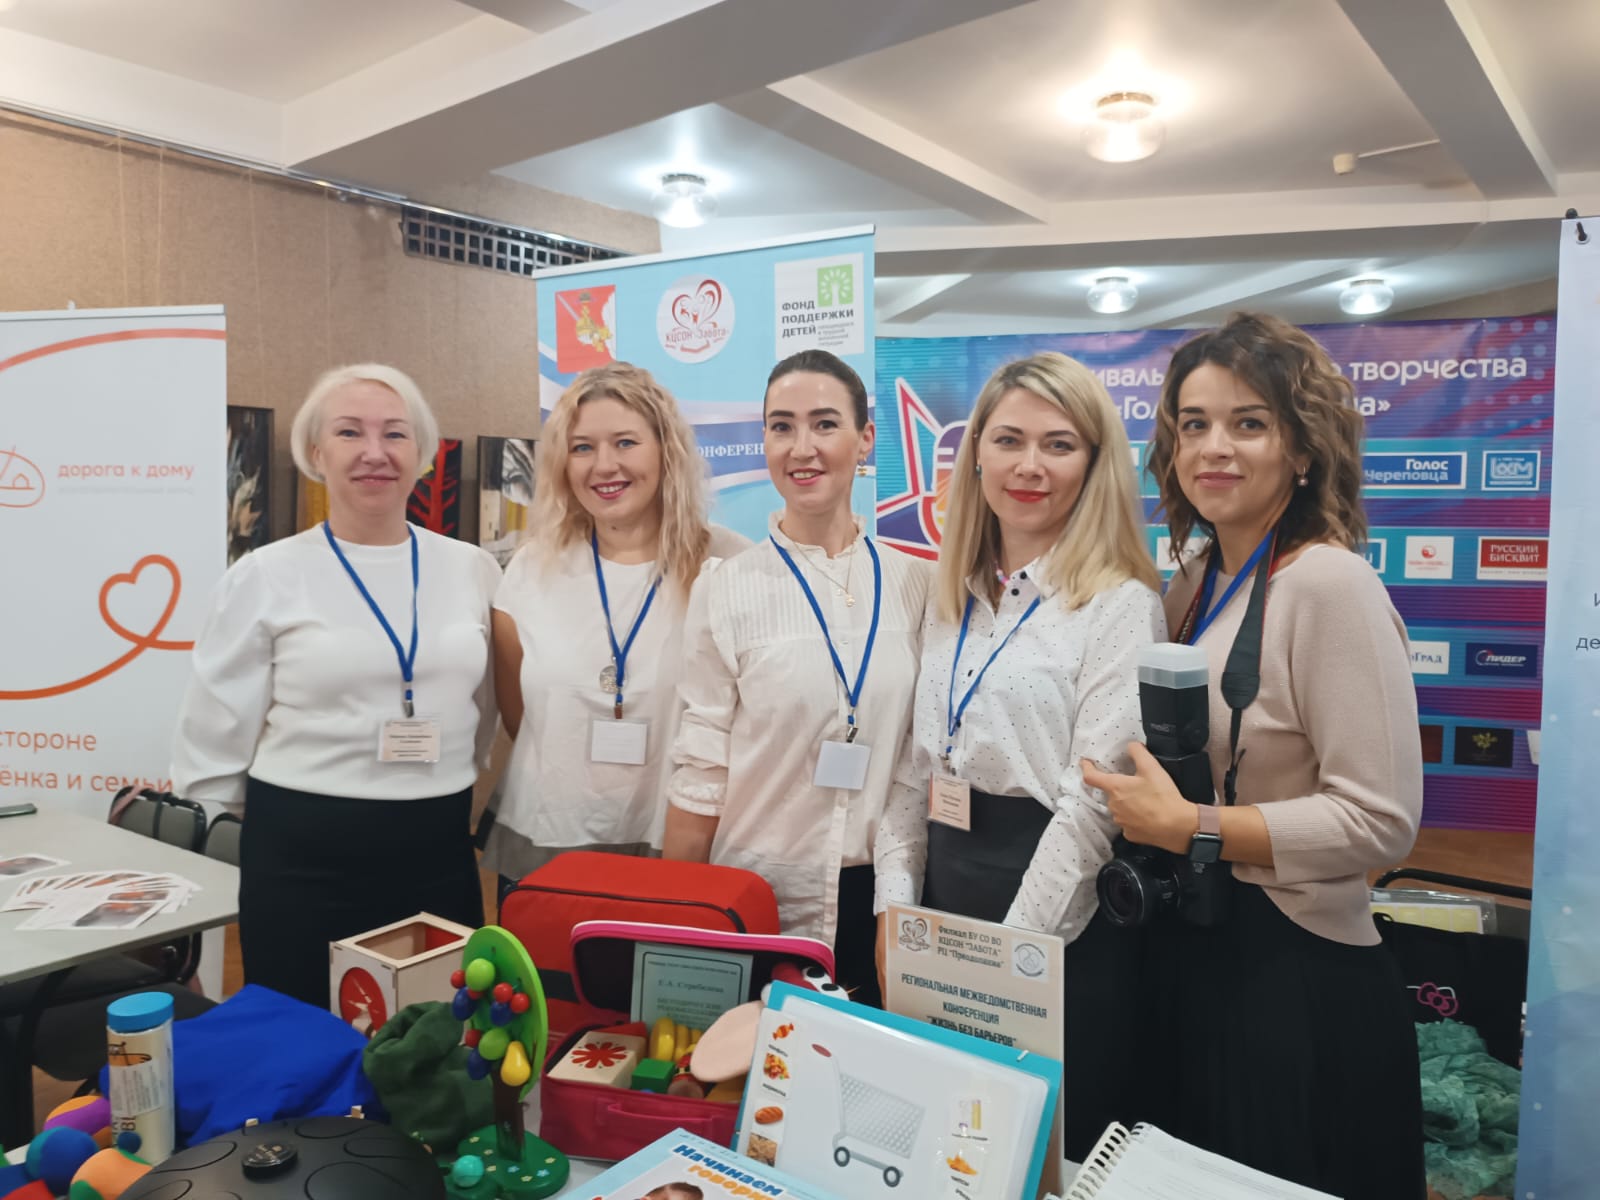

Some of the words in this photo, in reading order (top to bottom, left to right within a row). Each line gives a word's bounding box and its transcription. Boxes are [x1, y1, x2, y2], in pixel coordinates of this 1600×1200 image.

[782, 300, 815, 311] ФОНД
[782, 309, 854, 324] ПОДДЕРЖКИ
[665, 330, 693, 343] КЦСОН
[782, 325, 817, 338] ДЕТЕЙ
[1349, 357, 1528, 386] творчества
[57, 464, 125, 480] дорога
[131, 465, 142, 478] к
[146, 464, 195, 480] дому
[1406, 458, 1449, 471] Голос
[1364, 469, 1449, 484] Череповца
[1489, 553, 1540, 563] БИСКВИТ
[67, 773, 82, 790] и
[979, 933, 990, 943] СО
[991, 936, 1002, 946] ВО
[901, 973, 959, 996] РЕГИОНАЛЬНАЯ
[959, 987, 1048, 1019] МЕЖВЕДОМСТВЕННАЯ
[942, 1001, 1000, 1025] КОНФЕРЕНЦИЯ
[958, 1023, 973, 1037] БЕЗ
[672, 1144, 784, 1196] Начинаем
